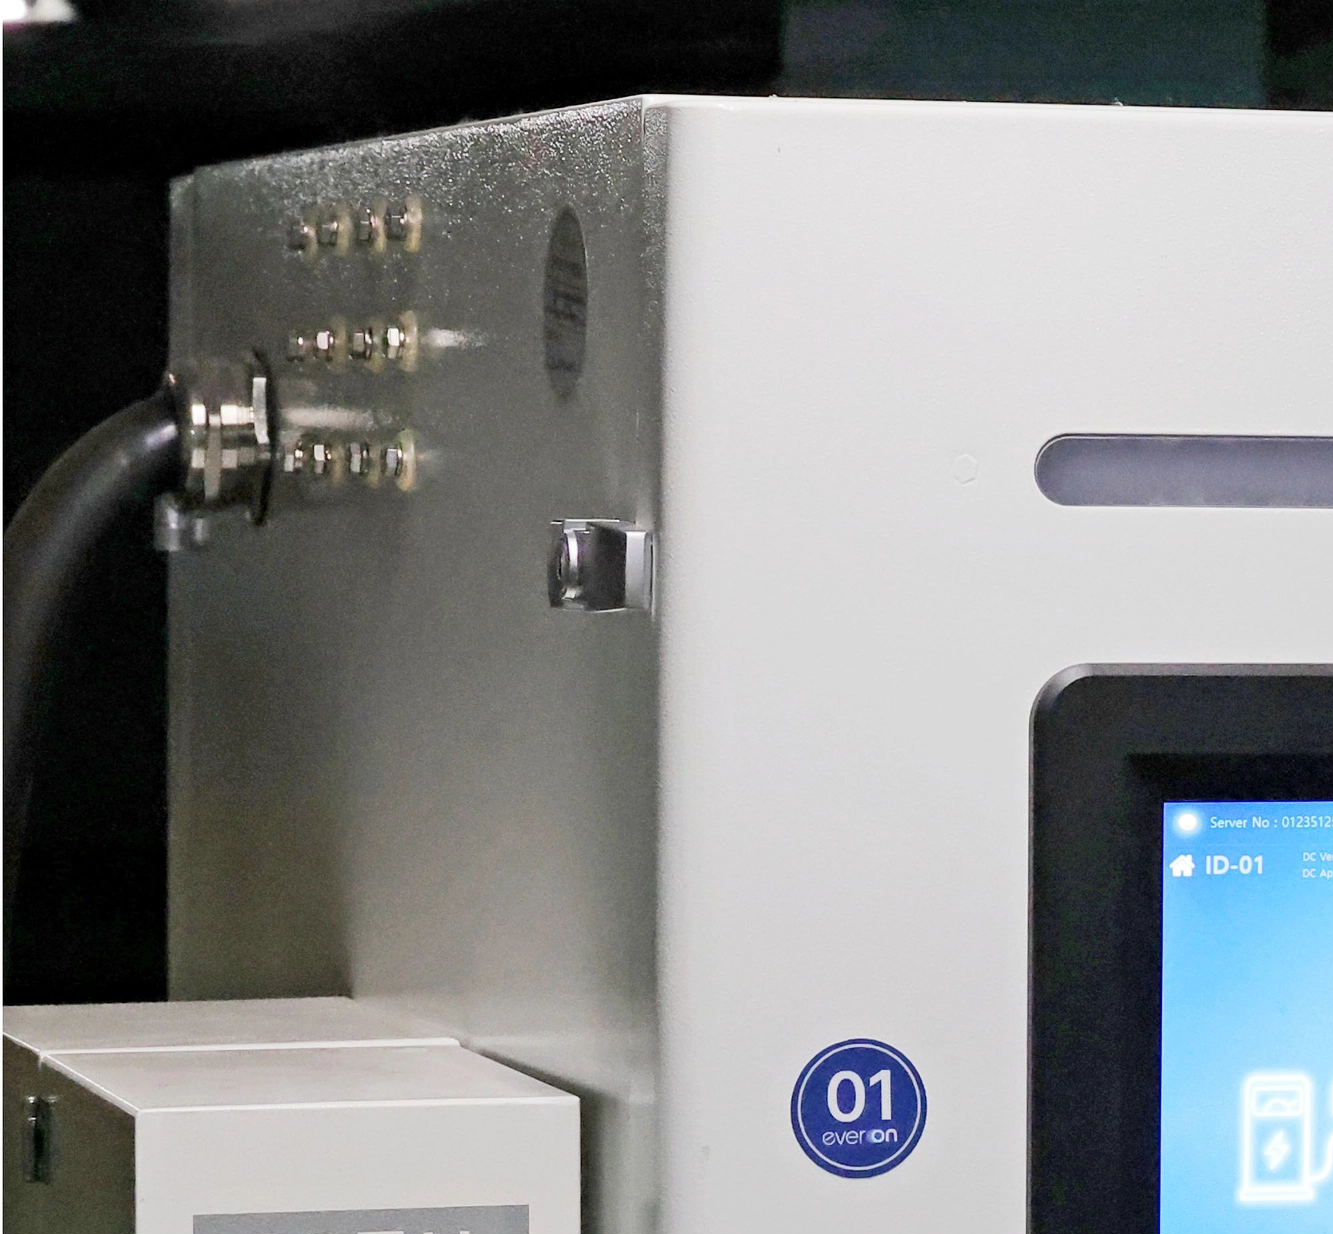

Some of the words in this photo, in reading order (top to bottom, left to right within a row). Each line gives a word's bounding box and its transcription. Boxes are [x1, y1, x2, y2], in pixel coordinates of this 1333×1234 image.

[1210, 817, 1248, 829] Server
[1252, 817, 1270, 828] No
[1303, 852, 1317, 862] DC
[1205, 855, 1264, 875] ID-01
[1302, 868, 1317, 878] DC
[827, 1069, 892, 1123] 01
